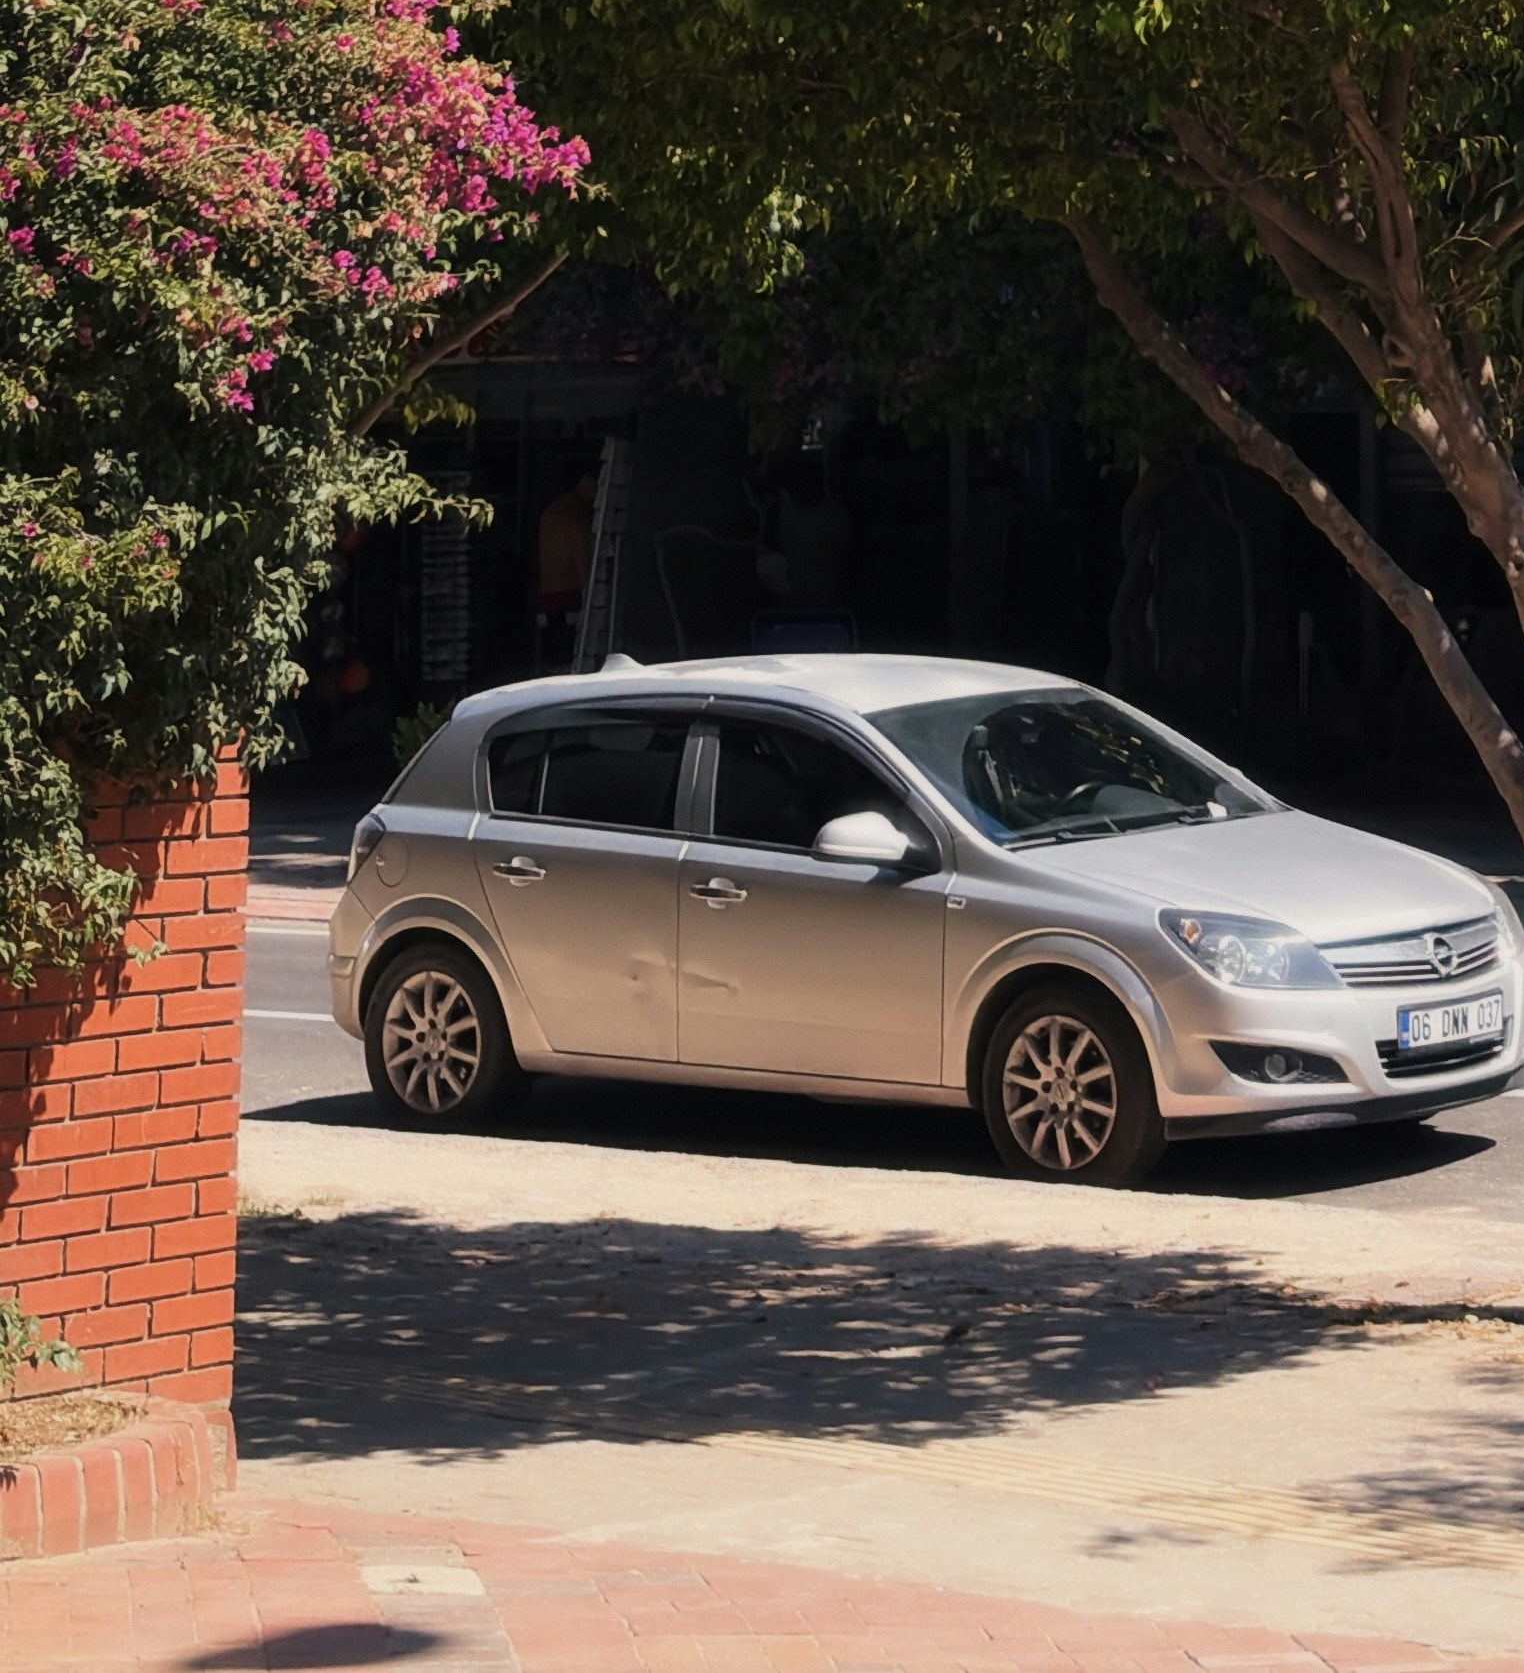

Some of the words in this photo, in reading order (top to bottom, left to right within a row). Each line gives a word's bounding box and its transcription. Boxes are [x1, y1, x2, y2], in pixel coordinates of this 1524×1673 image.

[1412, 1013, 1431, 1042] 06
[1442, 1007, 1468, 1037] DNN
[1478, 1000, 1499, 1029] 037
